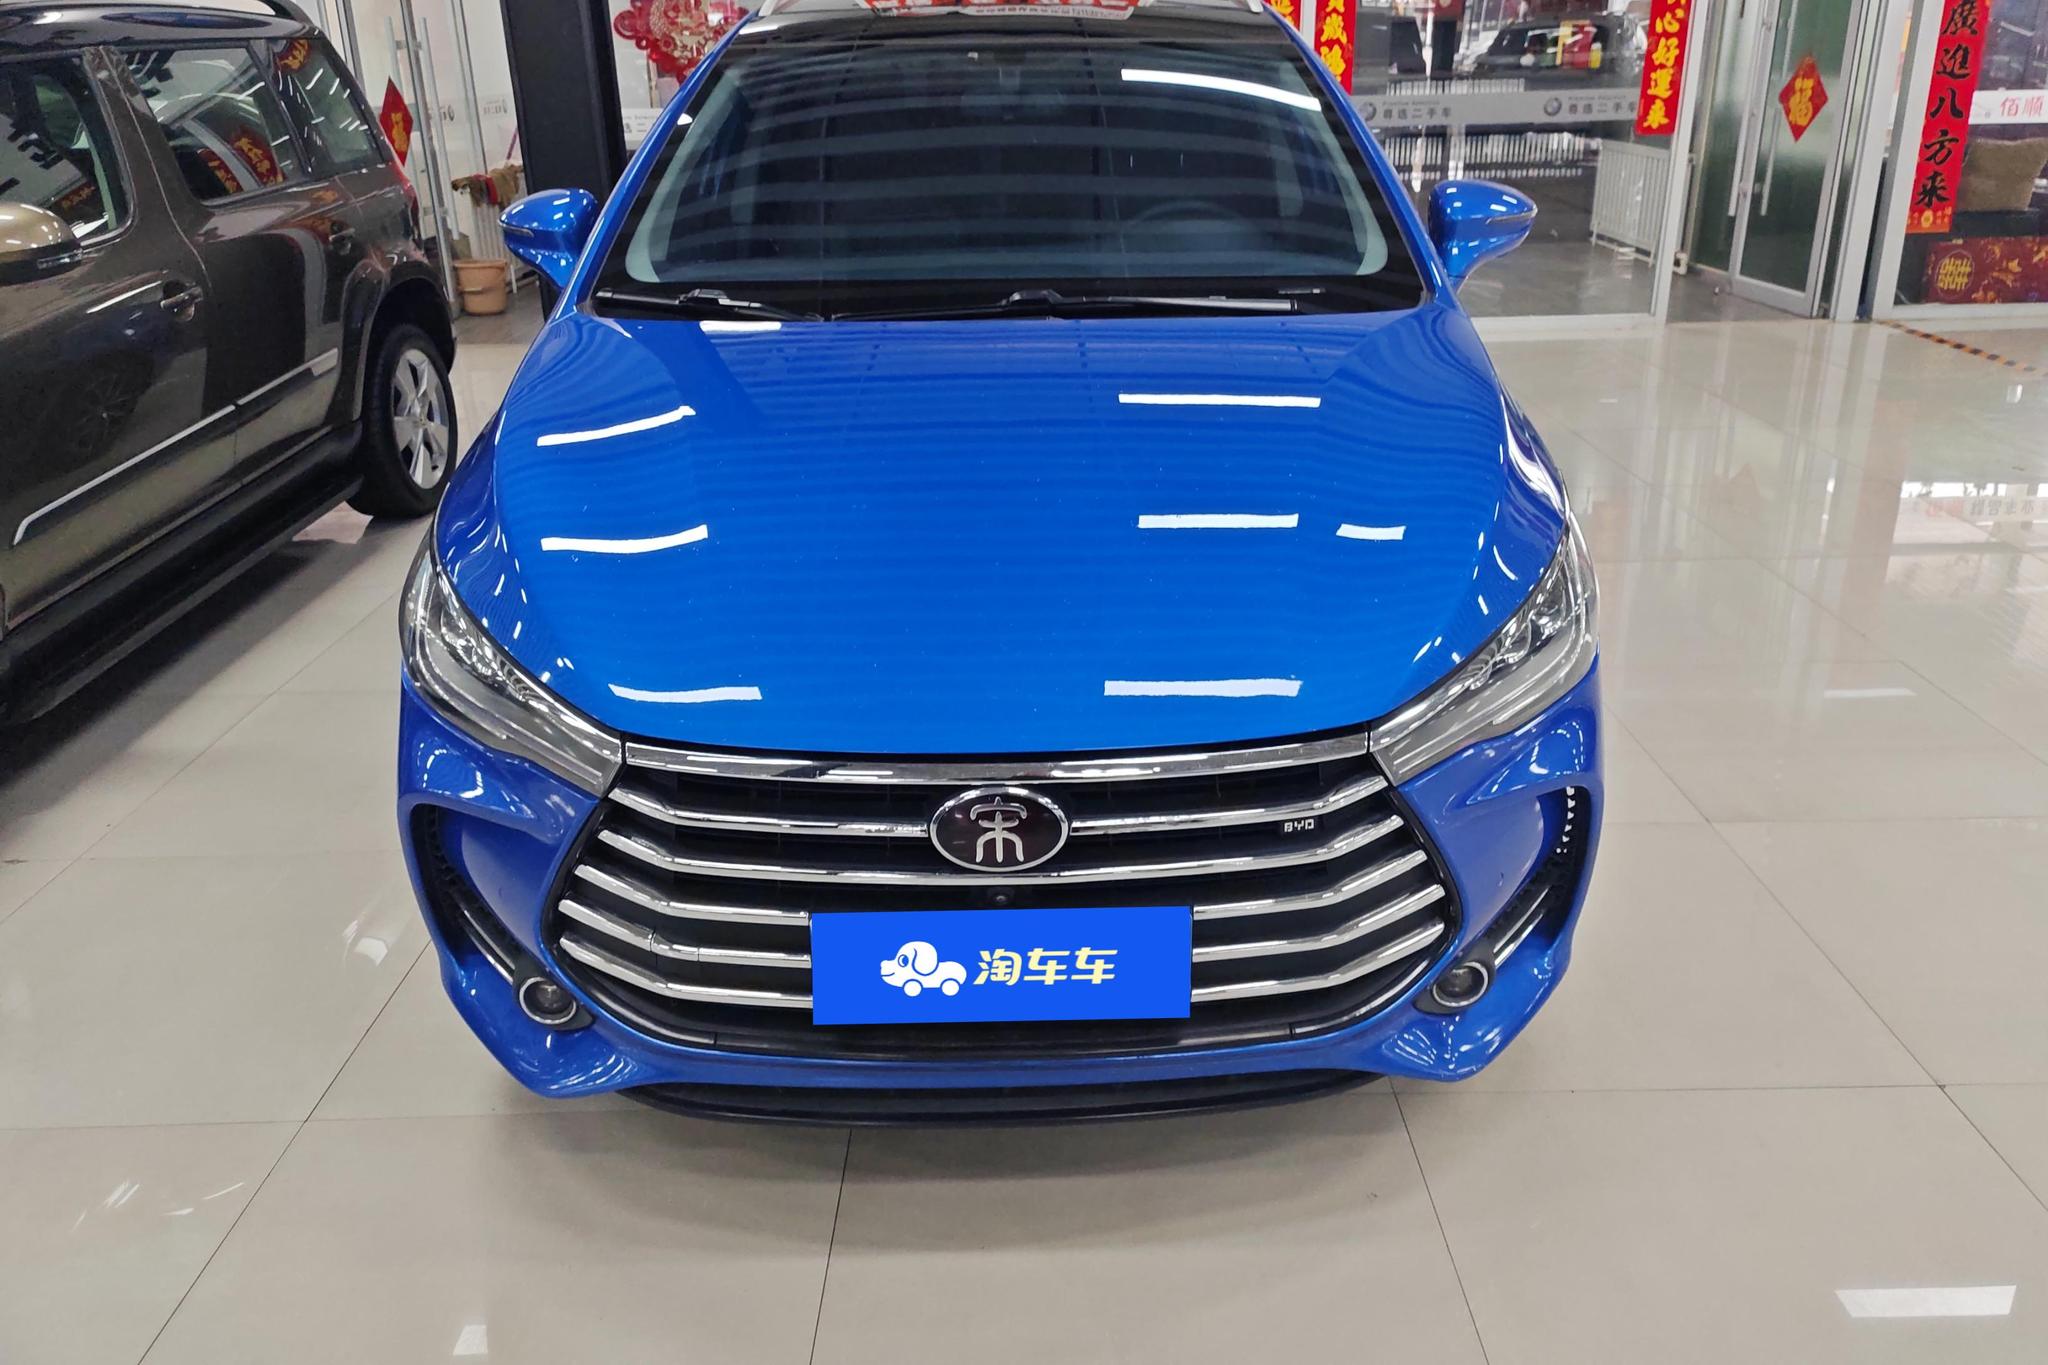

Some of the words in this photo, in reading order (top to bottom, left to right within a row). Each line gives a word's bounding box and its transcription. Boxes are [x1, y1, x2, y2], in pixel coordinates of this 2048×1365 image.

[1643, 0, 1686, 129] 心好運來
[1284, 818, 1315, 833] BYD
